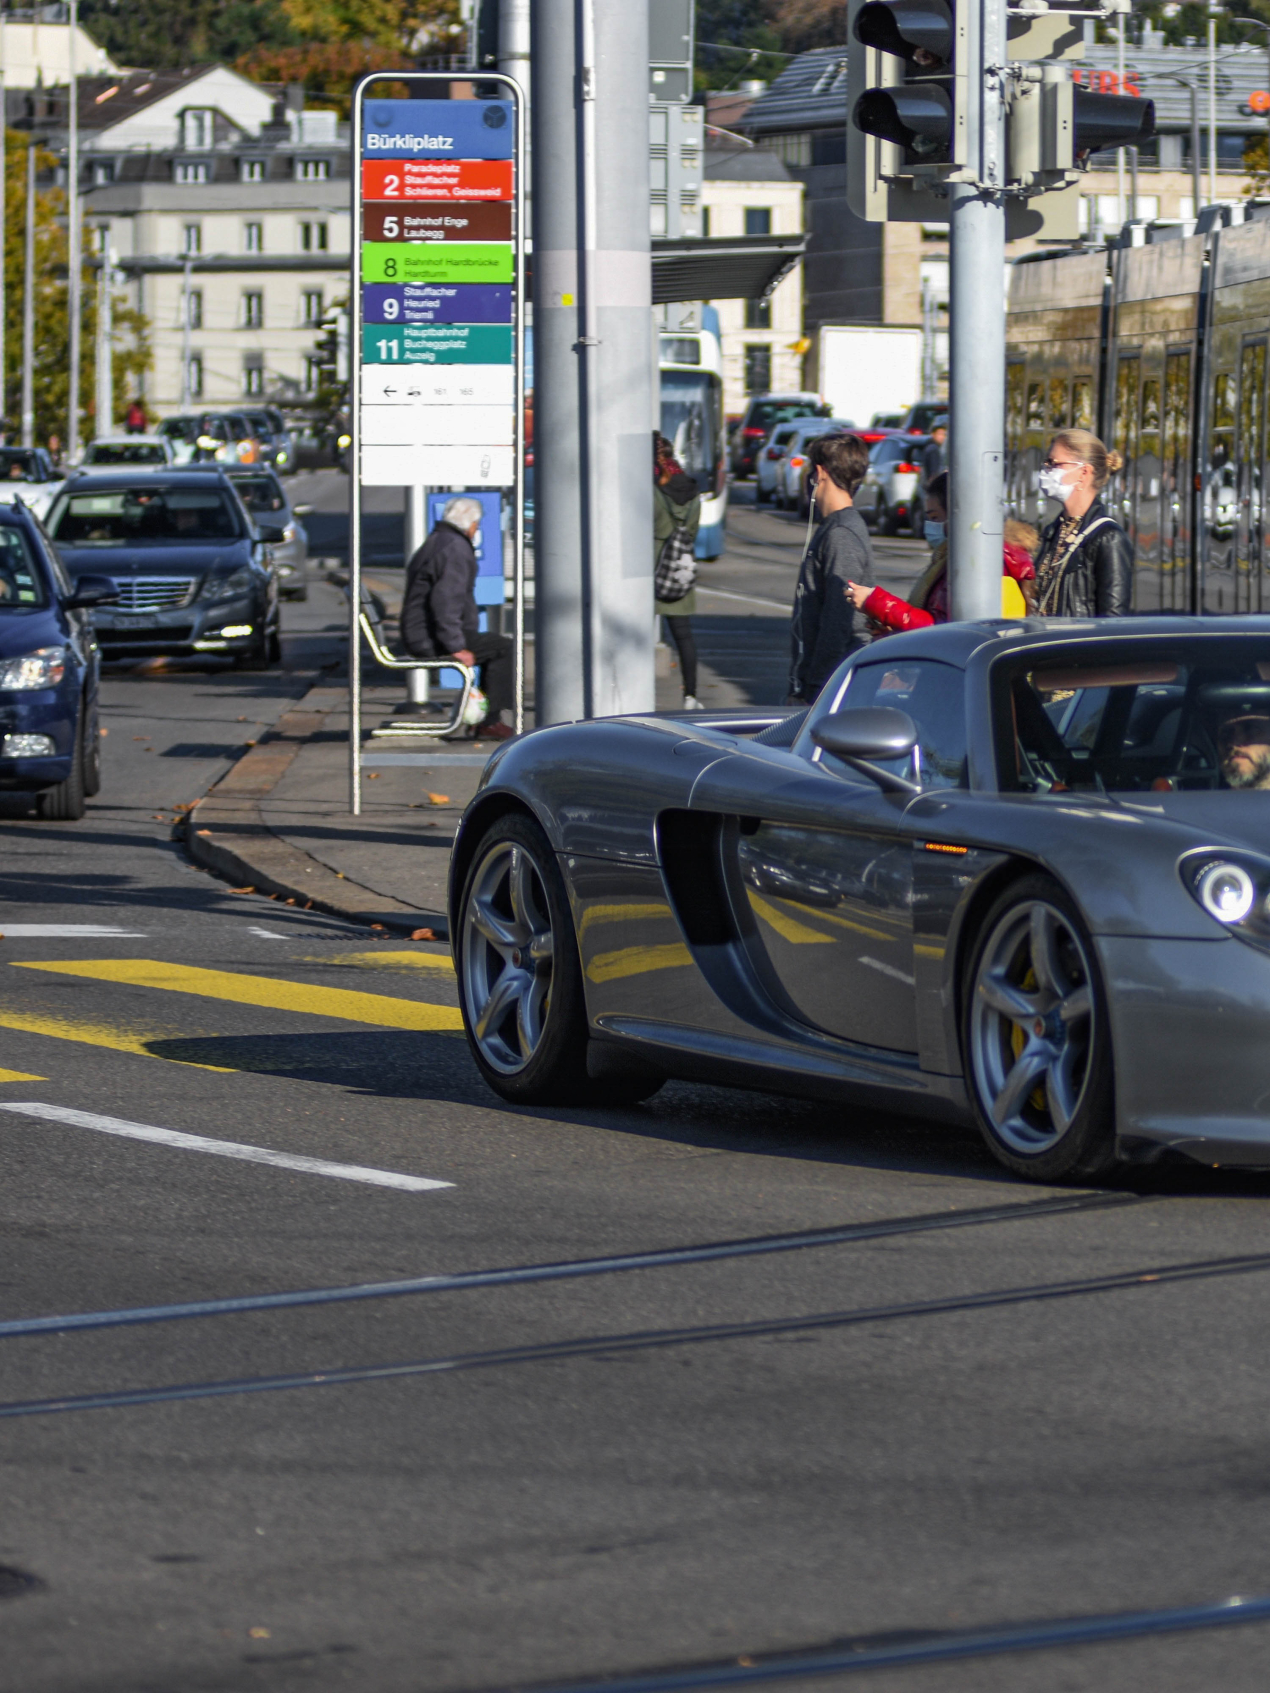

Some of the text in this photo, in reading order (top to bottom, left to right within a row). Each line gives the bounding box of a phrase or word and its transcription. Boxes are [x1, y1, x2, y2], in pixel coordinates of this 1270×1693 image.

[366, 133, 454, 152] Bürkliplatz
[403, 163, 461, 173] Paradeplatz
[403, 175, 460, 184] Stauffacher
[383, 174, 400, 196] 2
[403, 187, 451, 196] Schlieren,
[382, 216, 400, 238] 5
[403, 216, 469, 228] Bahnhof Enge
[403, 229, 445, 239] Laubegg
[404, 257, 500, 267] Bahnhof Hardbrücke
[383, 257, 398, 278] 8
[404, 270, 448, 278] Hardturm
[403, 287, 458, 296] Stauffacher
[403, 299, 441, 308] Heuried
[382, 298, 400, 320] 9
[403, 310, 434, 319] Triemli
[403, 327, 470, 338] Hauptbahnhof
[376, 339, 399, 360] 11
[403, 339, 468, 350] Bucheggplatz
